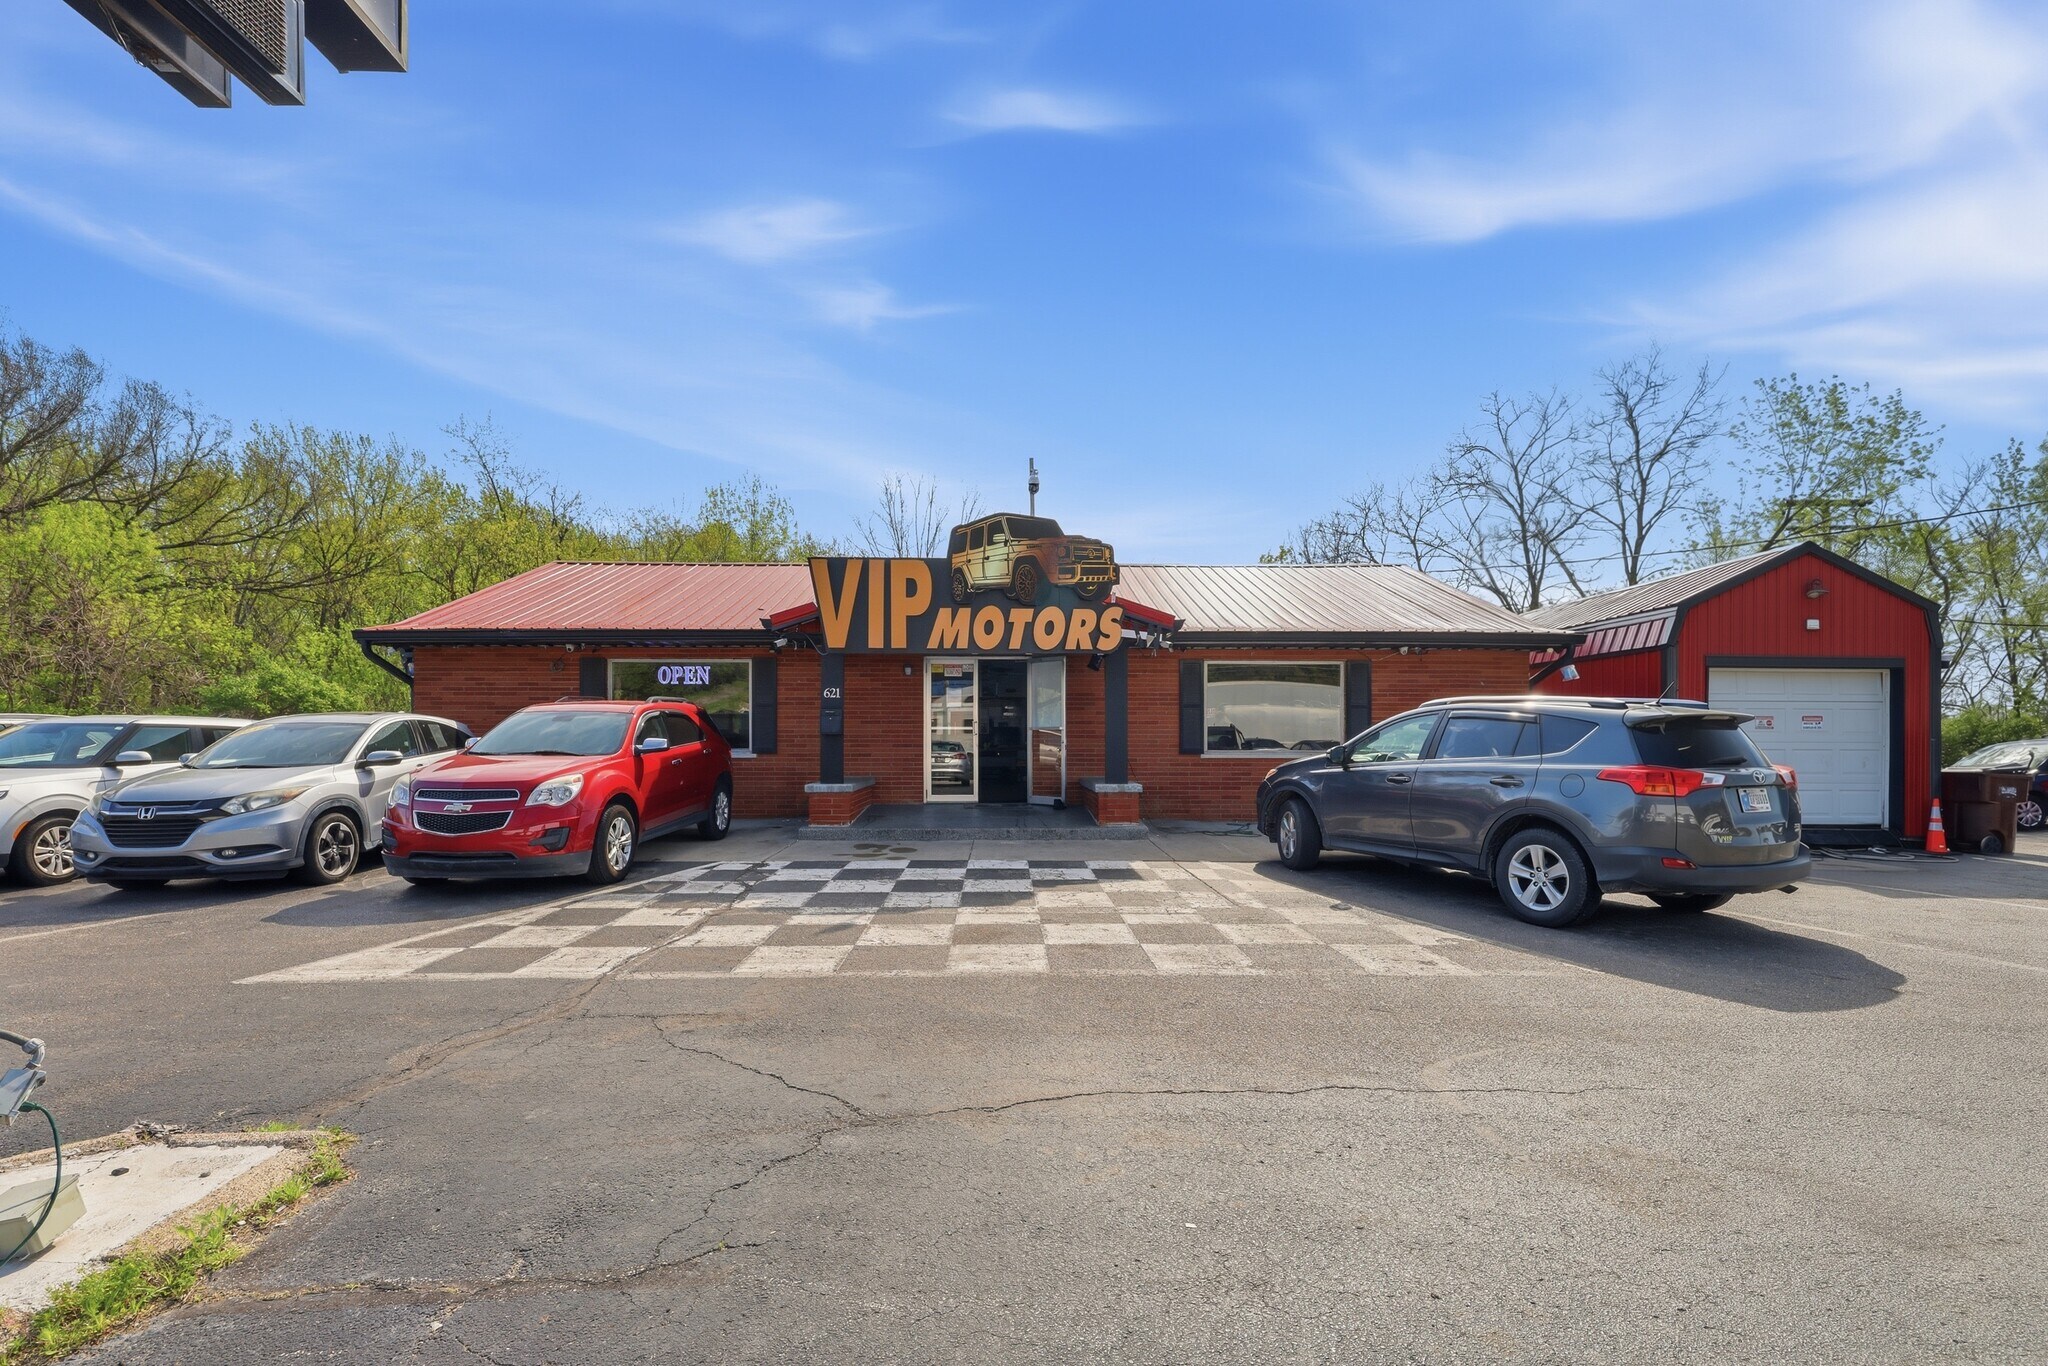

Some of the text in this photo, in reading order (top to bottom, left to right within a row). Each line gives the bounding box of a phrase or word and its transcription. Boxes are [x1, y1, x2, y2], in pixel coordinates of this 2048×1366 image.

[810, 558, 1125, 651] VIP MOTORS
[657, 665, 711, 685] OPEN
[823, 687, 841, 698] 621
